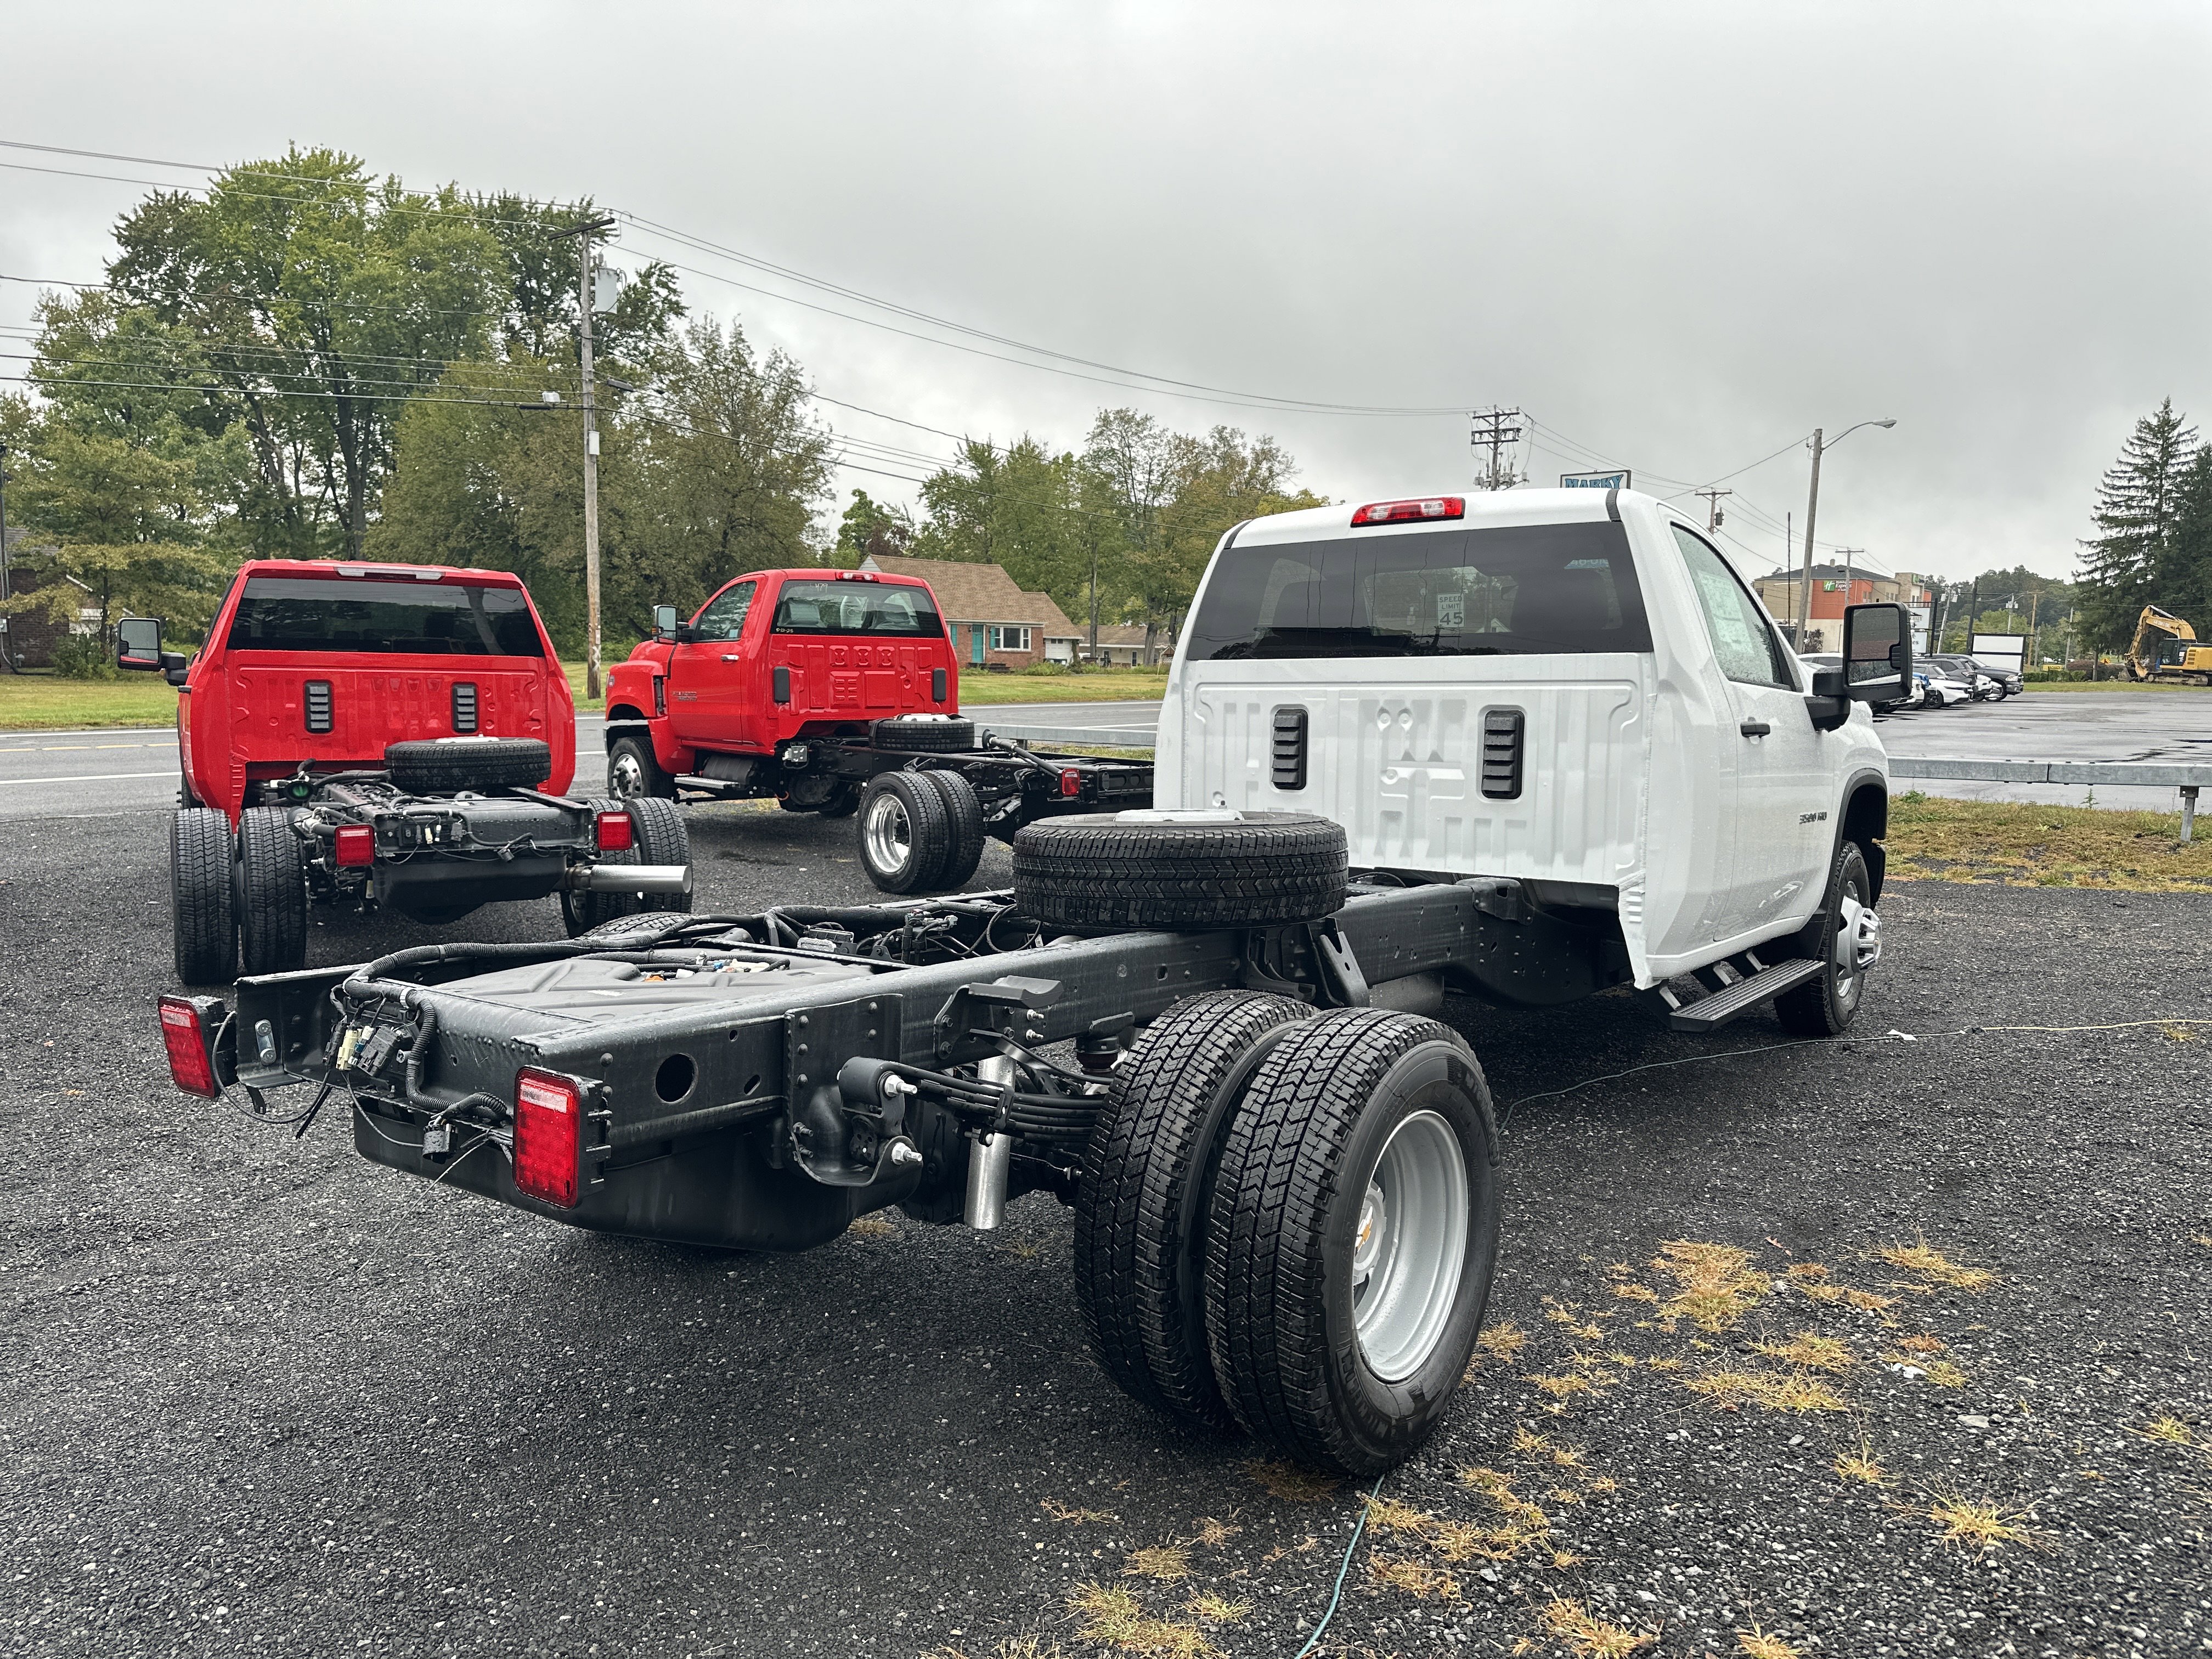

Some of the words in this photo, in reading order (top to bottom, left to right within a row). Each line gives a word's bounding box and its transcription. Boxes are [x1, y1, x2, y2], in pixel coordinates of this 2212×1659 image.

[1565, 474, 1624, 489] MARKY
[1440, 612, 1463, 625] 45
[1465, 1070, 1499, 1162] MICHELIN
